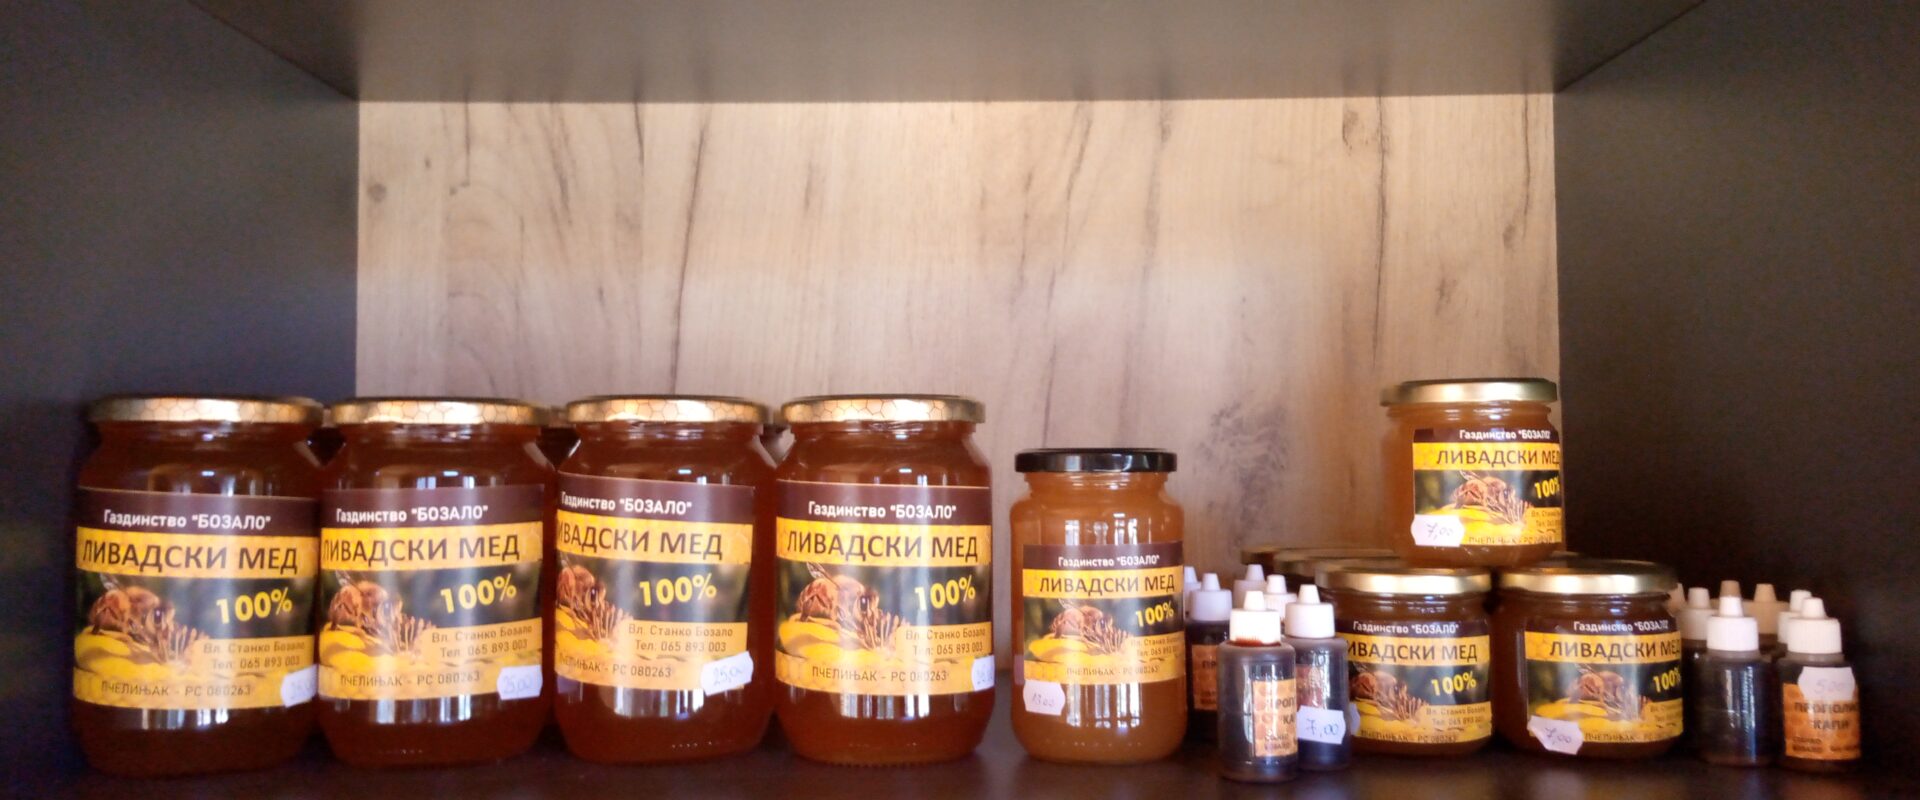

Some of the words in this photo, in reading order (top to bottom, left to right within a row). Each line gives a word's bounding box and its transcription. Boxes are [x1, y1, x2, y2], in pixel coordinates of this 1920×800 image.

[1459, 429, 1517, 440] Газдинство
[1436, 450, 1538, 467] ЛИВАДСКИ
[561, 491, 616, 511] Газдинство
[619, 498, 693, 515] "БОЗАЛО"
[808, 500, 886, 518] Газдинство
[890, 503, 957, 519] "БОЗАЛО"
[104, 508, 187, 527] Газдинство
[192, 513, 272, 530] "БОЗАЛО"
[336, 508, 407, 525] Газдинство
[411, 505, 489, 521] "БОЗАЛО"
[323, 538, 447, 568] ЛИВАДСКИ
[459, 534, 520, 561] МЕД
[660, 532, 723, 561] МЕД
[787, 531, 922, 562] ЛИВАДСКИ
[931, 536, 978, 563] МЕД
[83, 540, 227, 573] ЛИВАДСКИ
[238, 547, 298, 575] МЕД
[1058, 556, 1115, 567] Газдинство
[1117, 554, 1160, 566] "БОЗАЛО"
[440, 573, 517, 613] 100%
[639, 573, 717, 606] 100%
[914, 574, 976, 611] 100%
[1039, 577, 1139, 596] ЛИВАДСКИ
[1144, 574, 1175, 592] МЕД
[216, 587, 293, 624] 100%
[1135, 601, 1175, 628] 100%
[455, 629, 497, 643] Станко
[650, 624, 692, 637] Станко
[695, 625, 733, 637] Бозало
[927, 628, 960, 641] Станко
[1353, 621, 1409, 633] Газдинство
[1411, 623, 1459, 635] "БОЗАЛО"
[1573, 620, 1633, 632] Газдинство
[467, 644, 488, 656] 065
[492, 641, 510, 654] 893
[512, 638, 528, 651] 003
[661, 641, 681, 652] 065
[685, 641, 705, 652] 893
[708, 641, 727, 652] 003
[936, 644, 952, 656] 065
[956, 642, 971, 654] 893
[1347, 640, 1435, 662] ИВАДСКИ
[1441, 644, 1478, 662] МЕД
[1550, 641, 1656, 662] ЛИВАДСКИ
[240, 657, 260, 669] 065
[264, 657, 282, 668] 893
[630, 666, 672, 678] 080263
[812, 665, 877, 681] ПЧЕЛИЊАК
[1431, 671, 1477, 696] 100%
